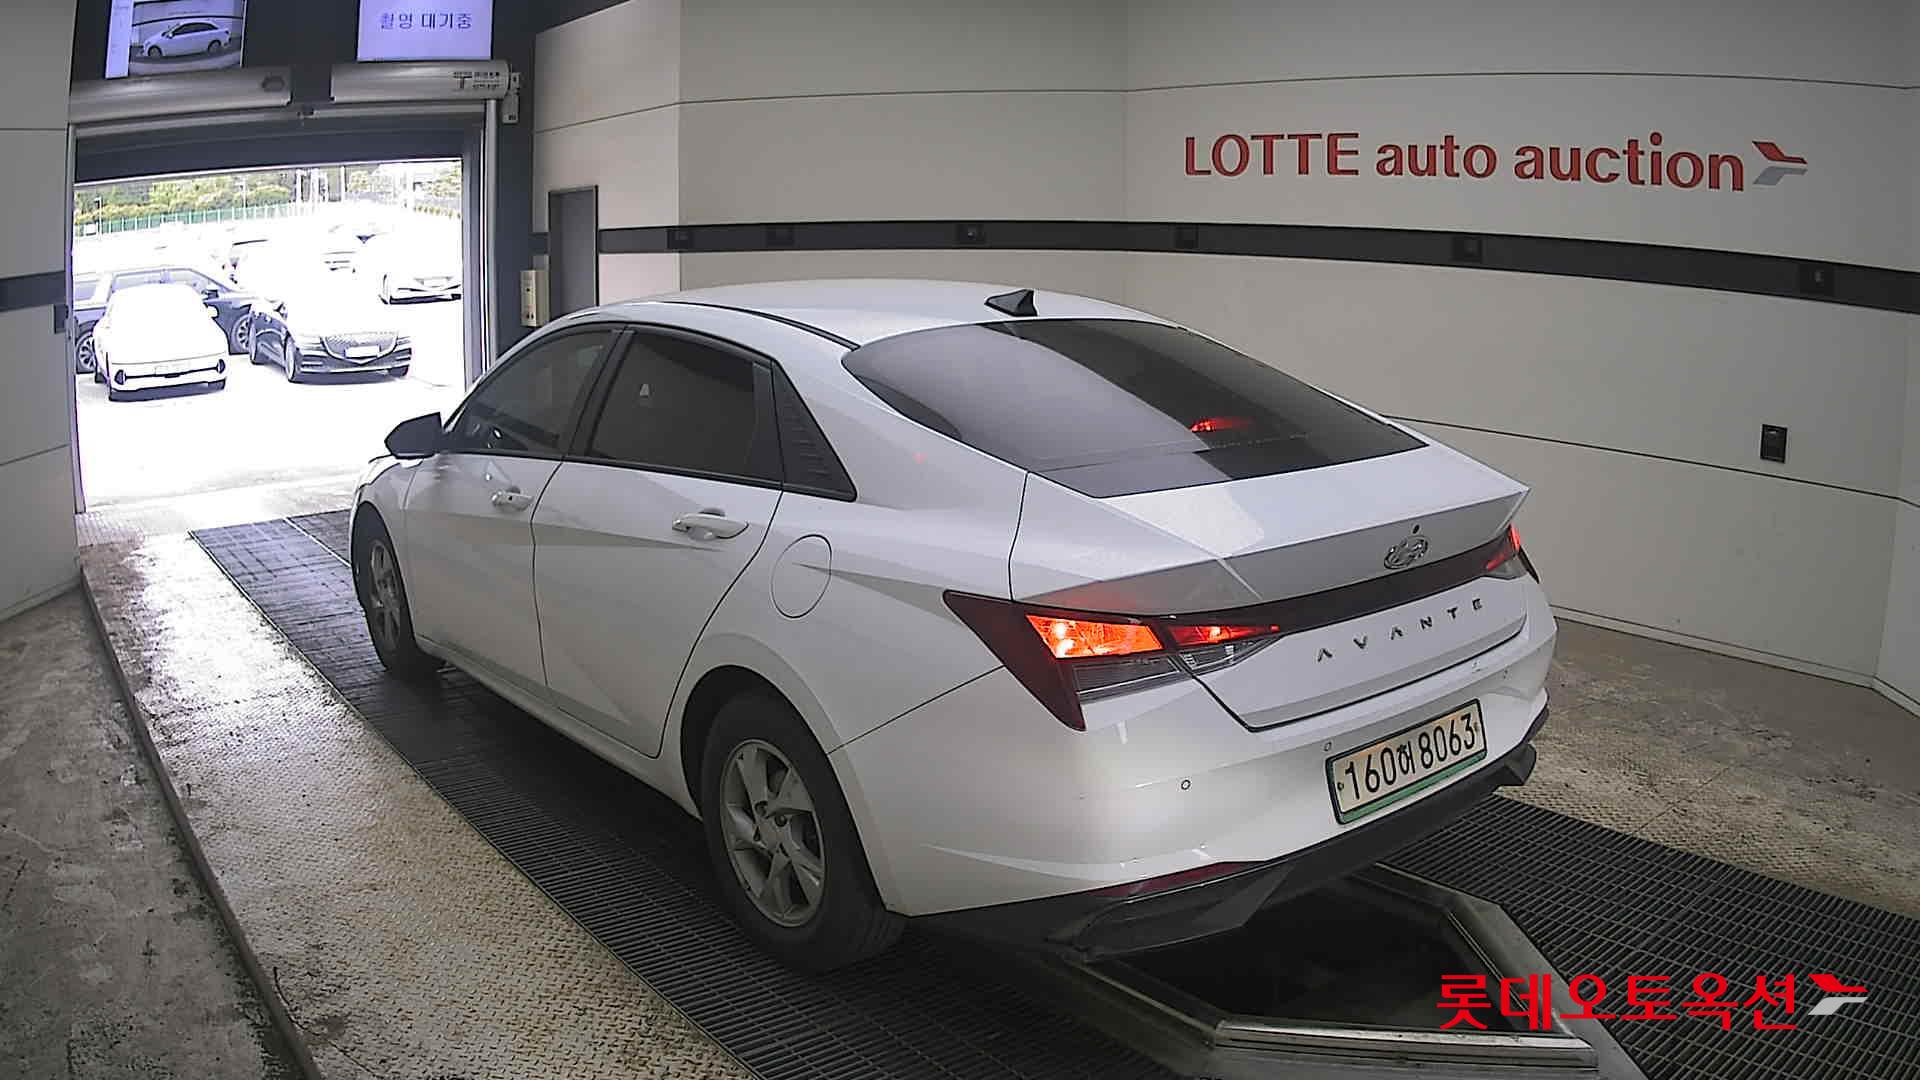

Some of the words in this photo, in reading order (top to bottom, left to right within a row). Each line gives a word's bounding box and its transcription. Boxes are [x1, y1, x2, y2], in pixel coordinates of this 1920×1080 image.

[421, 12, 473, 30] 대기중
[1184, 132, 1360, 177] LOTTE
[1375, 134, 1498, 179] auto
[1513, 131, 1745, 192] auction
[1316, 597, 1484, 663] AVANTE
